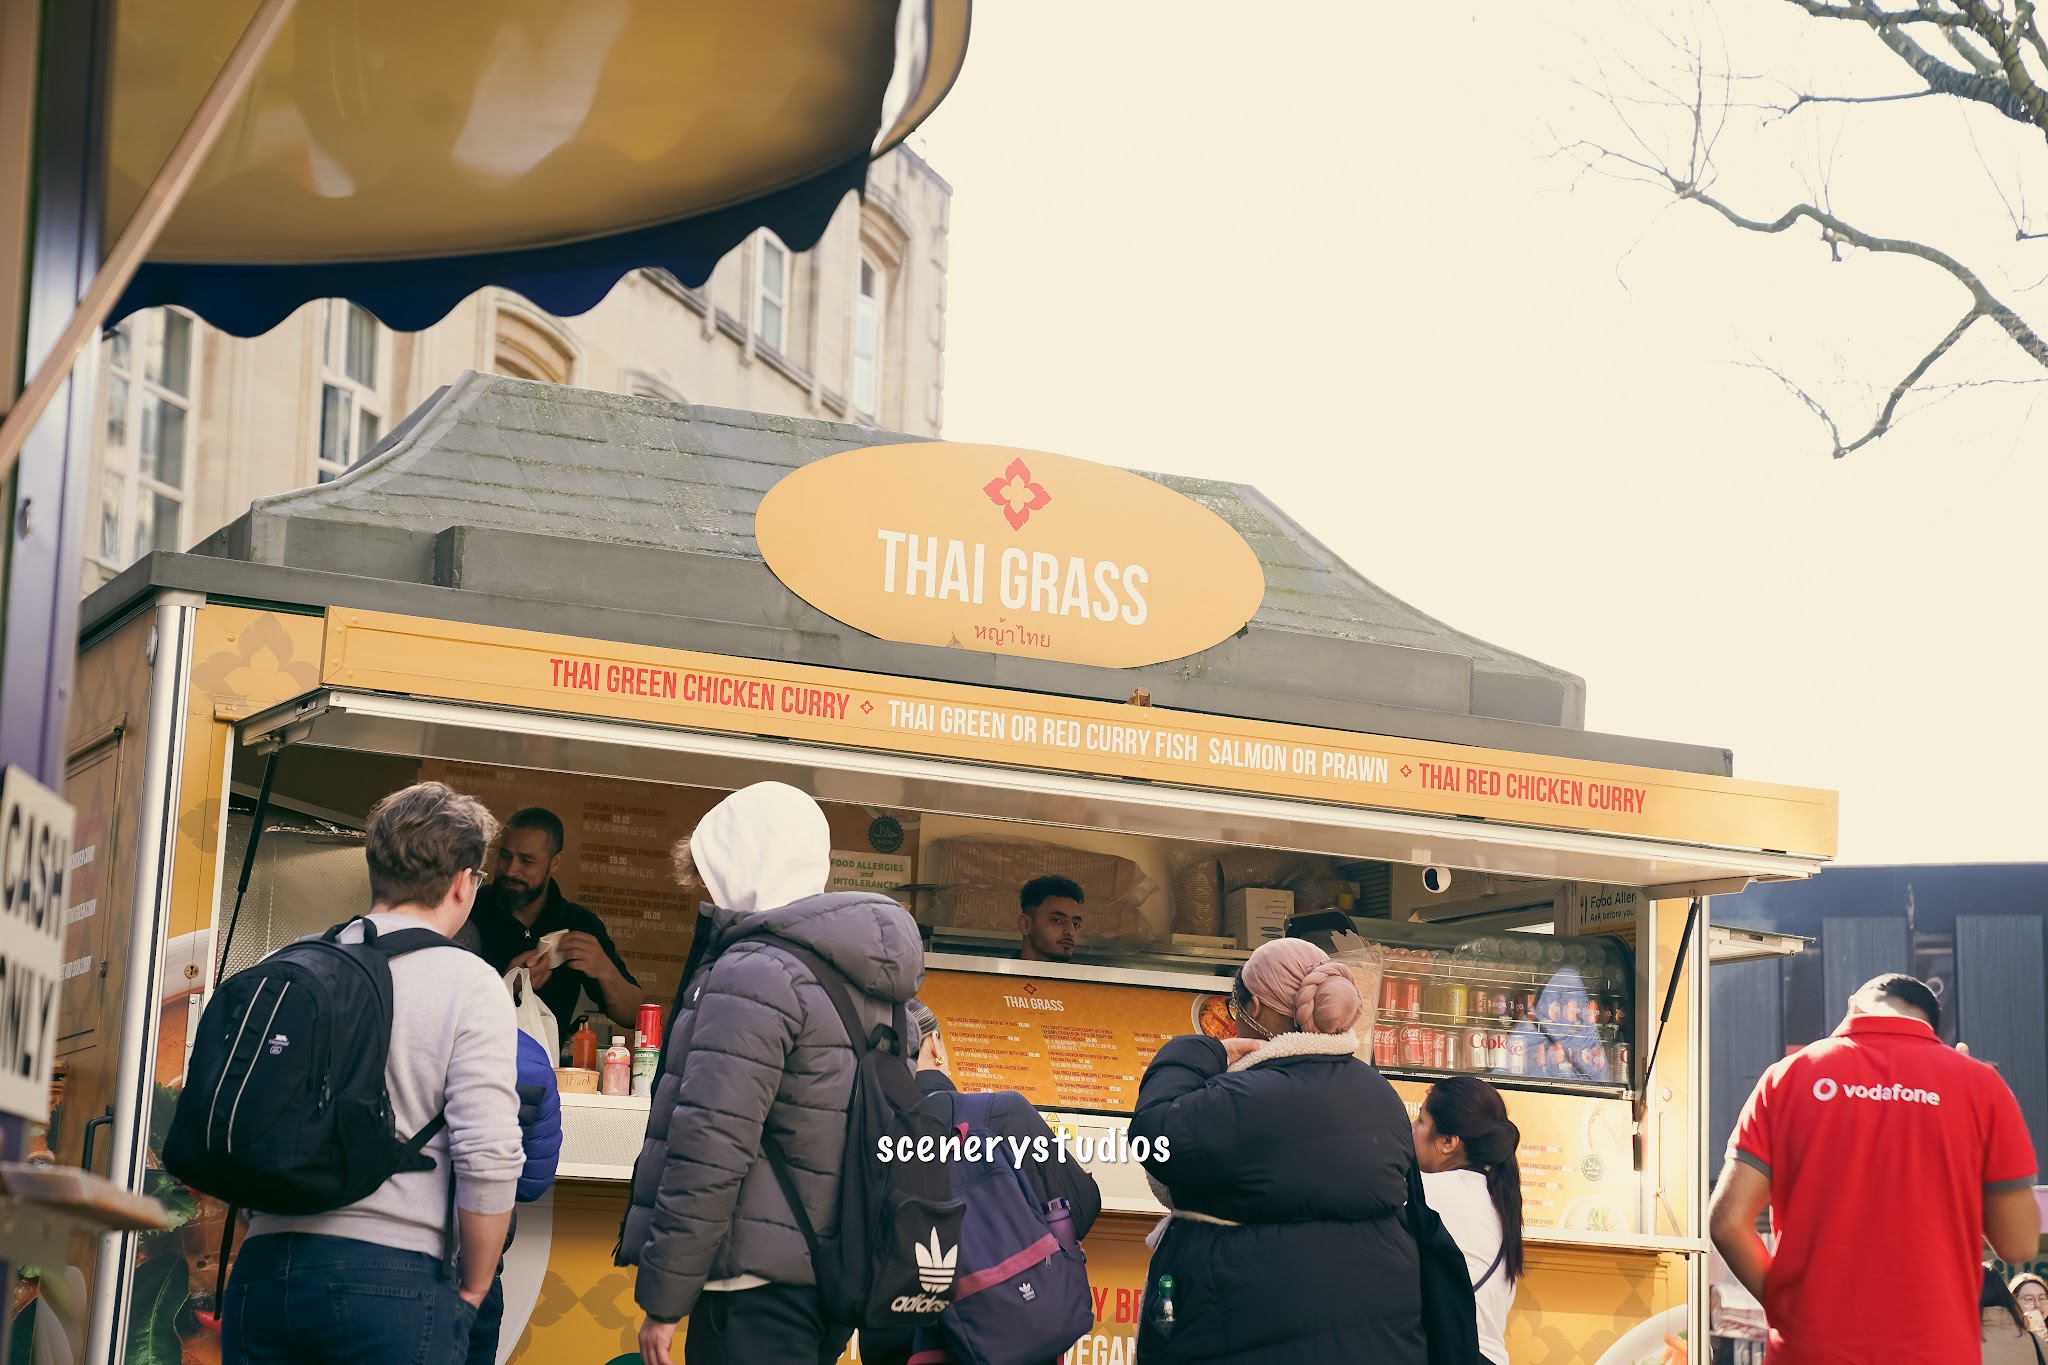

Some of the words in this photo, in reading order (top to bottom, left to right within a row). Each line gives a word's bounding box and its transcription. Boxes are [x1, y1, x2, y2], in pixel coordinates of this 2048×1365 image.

[878, 529, 984, 605] THAI
[1000, 546, 1148, 626] GRASS
[975, 617, 1050, 647] หญ้าไทย
[550, 659, 600, 690] THAI
[607, 665, 677, 698] GREEN
[683, 674, 775, 711] CHICKEN
[781, 686, 850, 720] CURRY
[888, 700, 935, 731] THAI
[940, 705, 1004, 739] GREEN
[1011, 715, 1036, 743] OR
[1043, 718, 1080, 747] RED
[1086, 723, 1150, 756] CURRY
[1156, 732, 1198, 761] FISH
[1209, 737, 1286, 772] SALMON
[1292, 748, 1316, 776] OR
[1322, 751, 1388, 784] PRAWN
[1419, 763, 1460, 791] THAI
[1466, 768, 1500, 797] RED
[1506, 774, 1582, 806] CHICKEN
[1588, 783, 1646, 813] CURRY
[583, 812, 598, 820] WITH
[584, 802, 612, 812] EGGPLANT
[628, 806, 647, 816] GREEN
[648, 808, 666, 817] CURRY
[580, 842, 613, 853] BUTTERNUT
[614, 846, 636, 856] SQUASH
[580, 852, 594, 861] WITH
[4, 802, 67, 942] CASH
[831, 859, 854, 868] FOOD
[857, 861, 904, 872] ALLERGIES
[834, 877, 900, 889] INTOLERANCES
[578, 884, 592, 892] THAI
[592, 886, 612, 894] SWEET
[613, 887, 624, 895] AND
[626, 888, 641, 897] SOUR
[642, 890, 660, 899] CURRY
[662, 892, 676, 900] WITH
[678, 894, 691, 902] RICE
[1590, 894, 1612, 908] Food
[1615, 892, 1636, 904] Aller
[602, 896, 627, 906] CHICKEN
[628, 899, 636, 907] OR
[638, 900, 652, 909] TOFU
[662, 902, 691, 912] EGGPLANT
[620, 909, 643, 918] SQUASH
[1590, 912, 1601, 921] Ask
[1603, 910, 1621, 920] before
[1622, 909, 1635, 918] you
[637, 952, 651, 960] TOFU
[651, 953, 669, 961] GREEN
[1004, 996, 1029, 1009] THAI
[1030, 998, 1064, 1012] GRASS
[561, 1074, 592, 1087] Thank
[1843, 1083, 1940, 1106] vodafone
[891, 1293, 950, 1313] adidas
